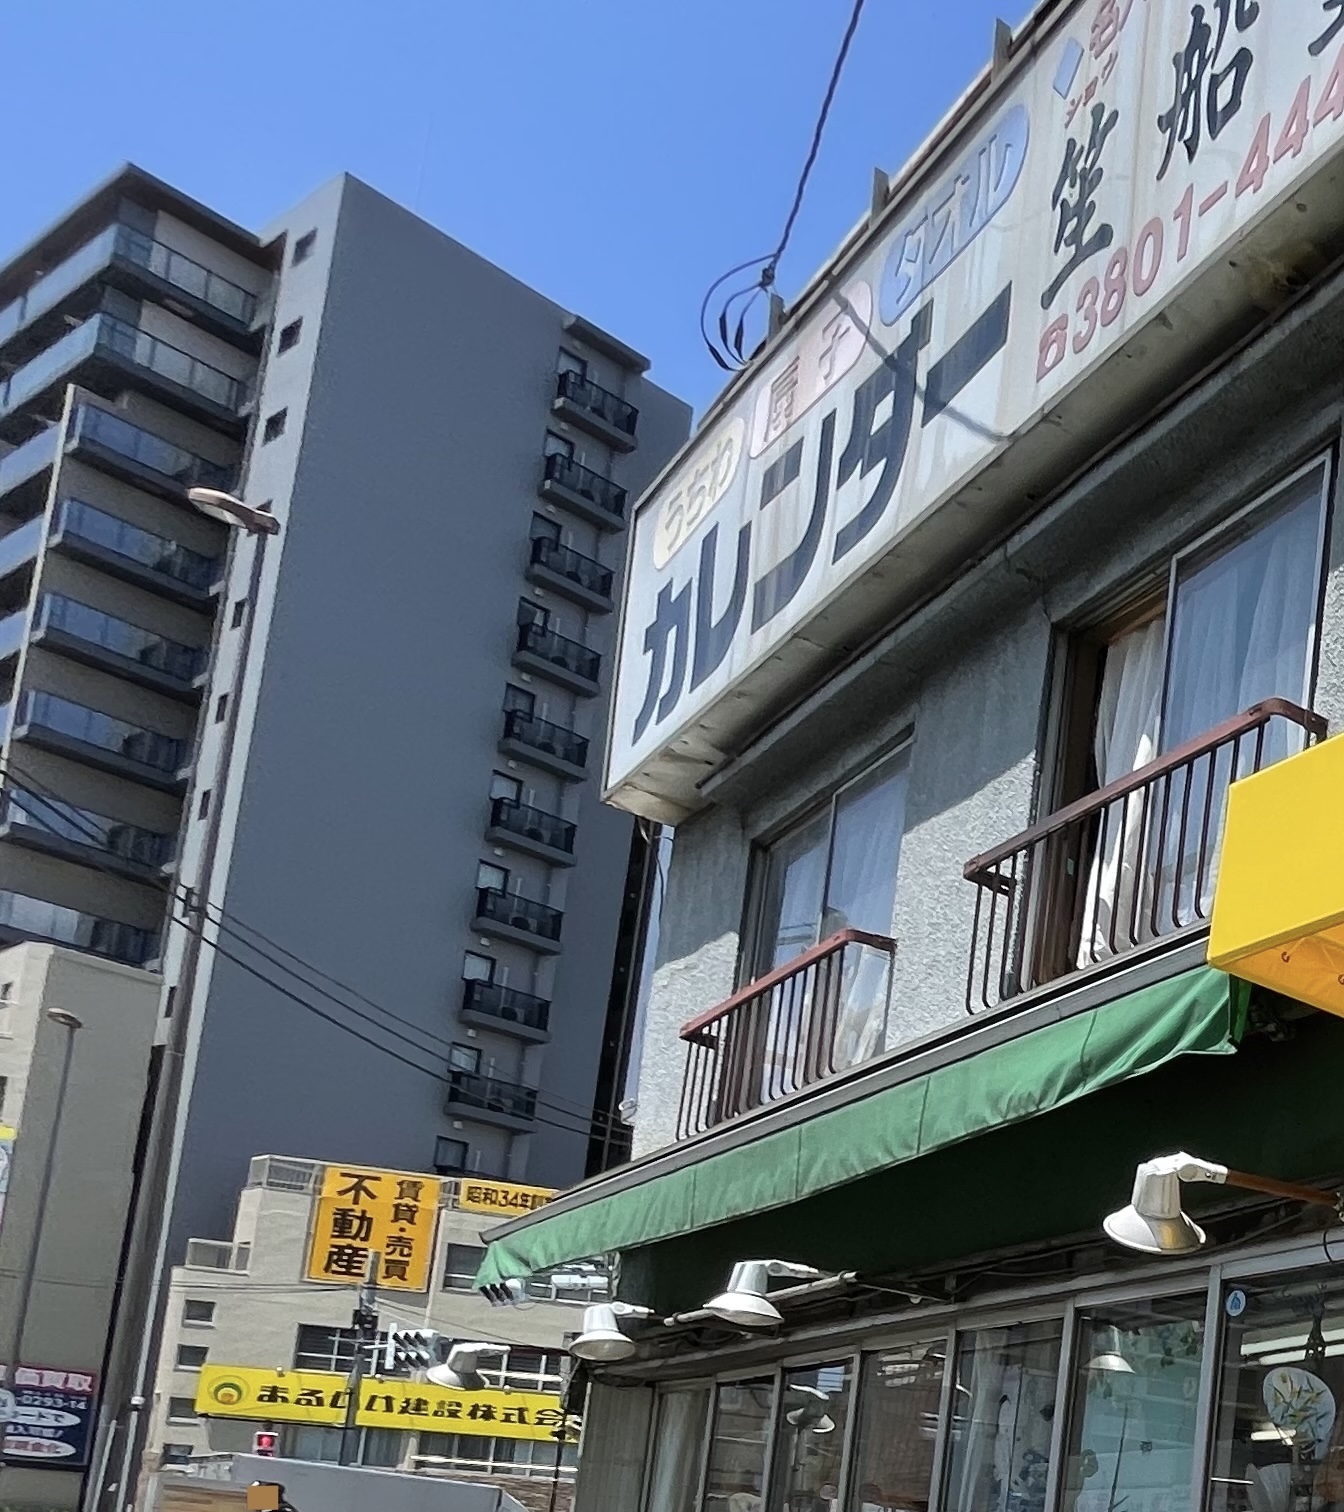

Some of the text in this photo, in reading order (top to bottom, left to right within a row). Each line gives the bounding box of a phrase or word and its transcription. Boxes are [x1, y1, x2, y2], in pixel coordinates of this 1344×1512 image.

[894, 134, 1013, 306] タオル
[632, 280, 1013, 748] カレンダー
[664, 436, 735, 553] うちわ
[323, 1172, 382, 1279] 不動産
